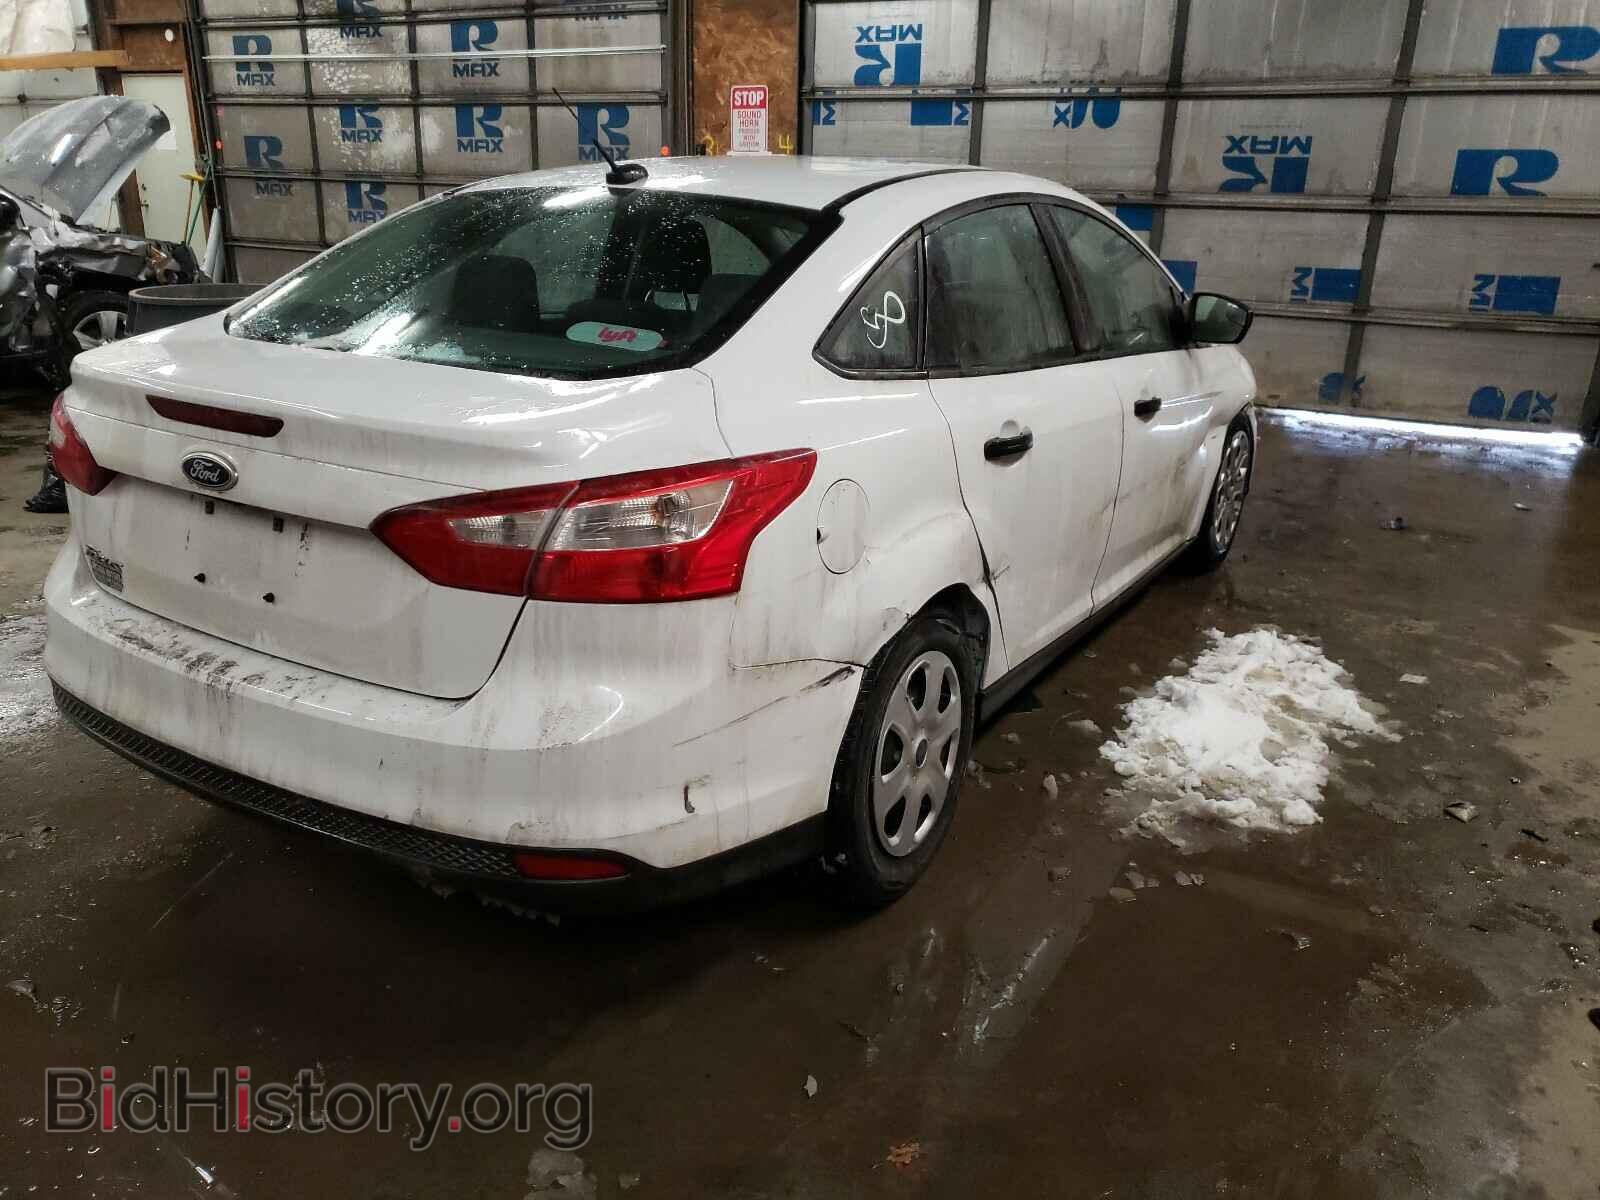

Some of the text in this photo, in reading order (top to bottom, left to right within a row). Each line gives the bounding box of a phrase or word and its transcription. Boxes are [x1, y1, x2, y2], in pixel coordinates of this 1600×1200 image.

[340, 24, 383, 38] MAX
[854, 24, 923, 43] MAX
[232, 35, 274, 72] R
[1491, 26, 1600, 76] R
[453, 63, 500, 78] MAX
[237, 73, 276, 86] MAX
[734, 90, 765, 106] STOP
[737, 111, 761, 119] SOUND
[577, 103, 631, 146] R
[739, 120, 759, 128] HORN
[341, 130, 383, 143] MAX
[457, 139, 504, 153] MAX
[1223, 135, 1313, 154] MAX
[1450, 149, 1560, 197] R
[256, 182, 293, 196] MAX
[190, 459, 222, 482] Ford
